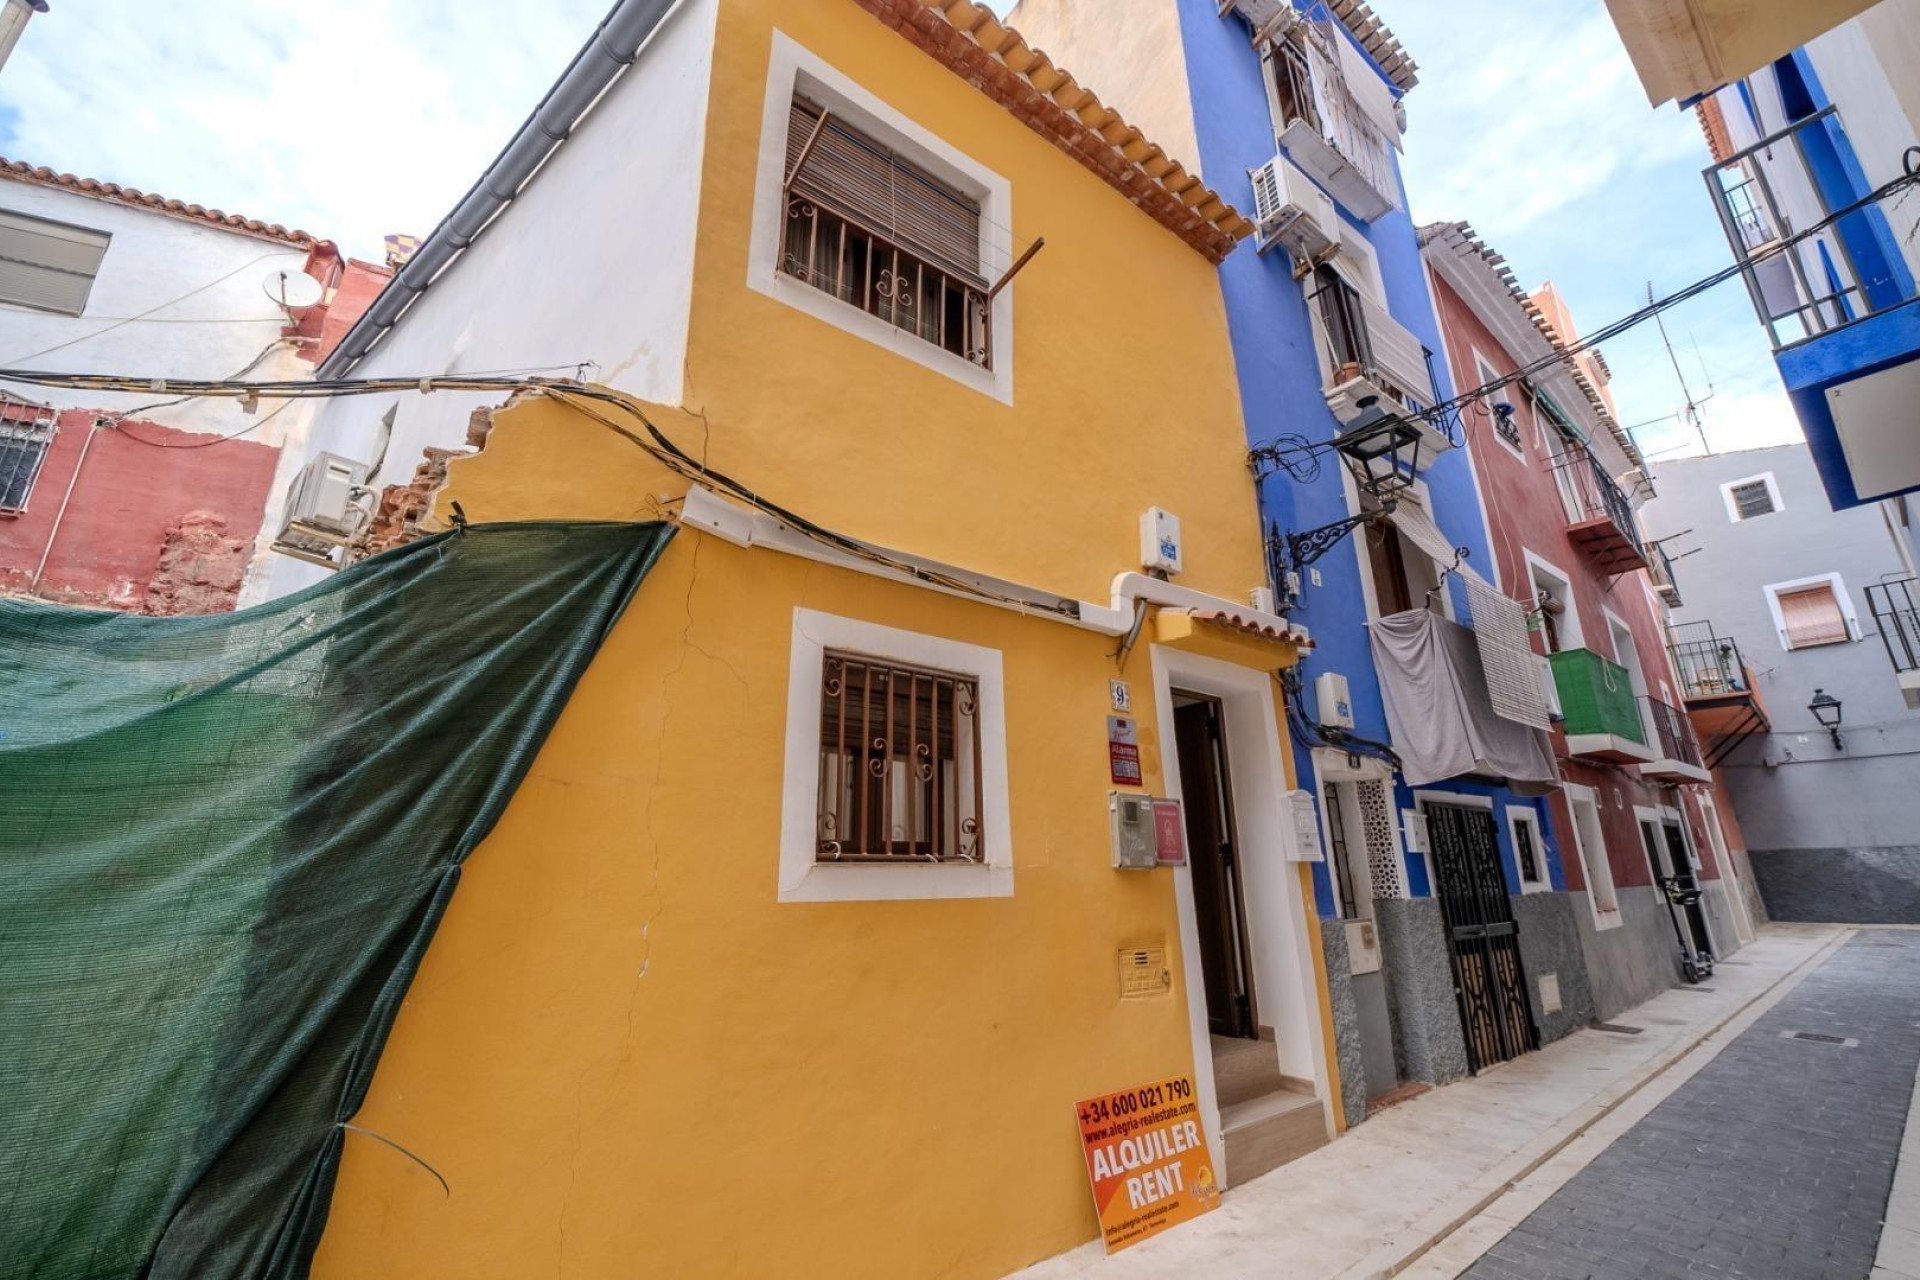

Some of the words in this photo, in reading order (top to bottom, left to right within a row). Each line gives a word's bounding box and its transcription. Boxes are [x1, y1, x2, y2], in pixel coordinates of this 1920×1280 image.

[1116, 685, 1125, 706] 9
[1081, 1100, 1109, 1125] +34
[1111, 1092, 1137, 1117] 600
[1139, 1087, 1164, 1111] 021
[1165, 1078, 1191, 1101] 790
[1084, 1102, 1197, 1144] www.alegria-realestate.com
[1093, 1120, 1201, 1182] ALQUILER
[1126, 1161, 1184, 1210] RENT
